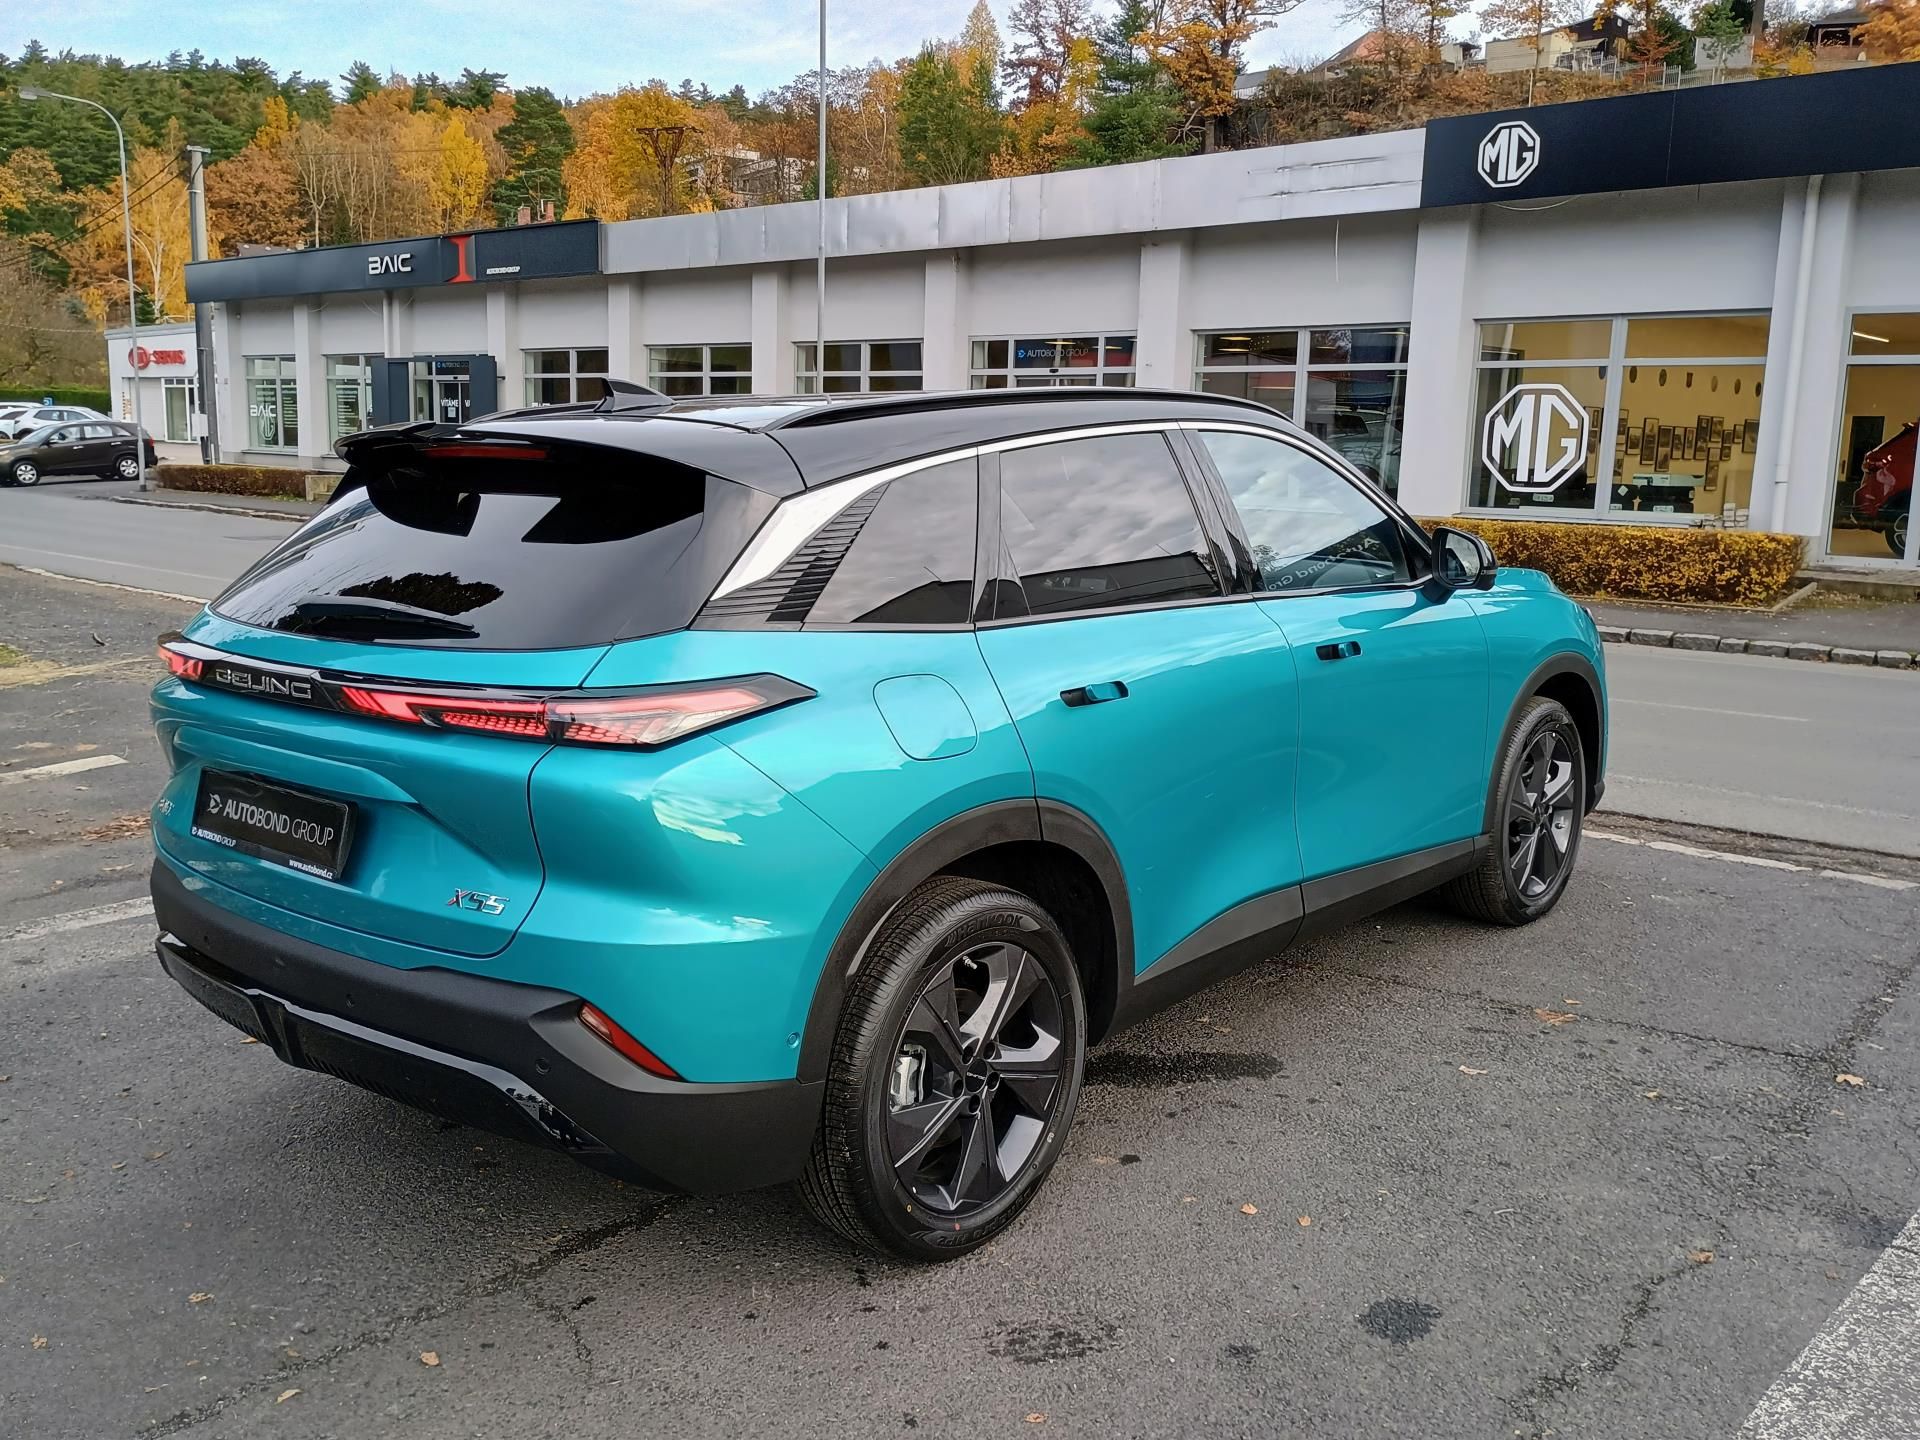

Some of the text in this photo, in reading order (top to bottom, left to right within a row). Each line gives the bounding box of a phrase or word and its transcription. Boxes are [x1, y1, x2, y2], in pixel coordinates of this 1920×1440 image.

[1483, 126, 1535, 182] MG
[368, 253, 411, 275] BAIC
[1027, 349, 1064, 358] AUTOBOD
[1491, 394, 1579, 483] MG
[215, 669, 312, 699] BEIJING
[223, 799, 334, 846] AUTOBOND GROUP
[197, 829, 237, 847] AUTOBOND GROUP
[289, 859, 333, 880] www.autobond.cz
